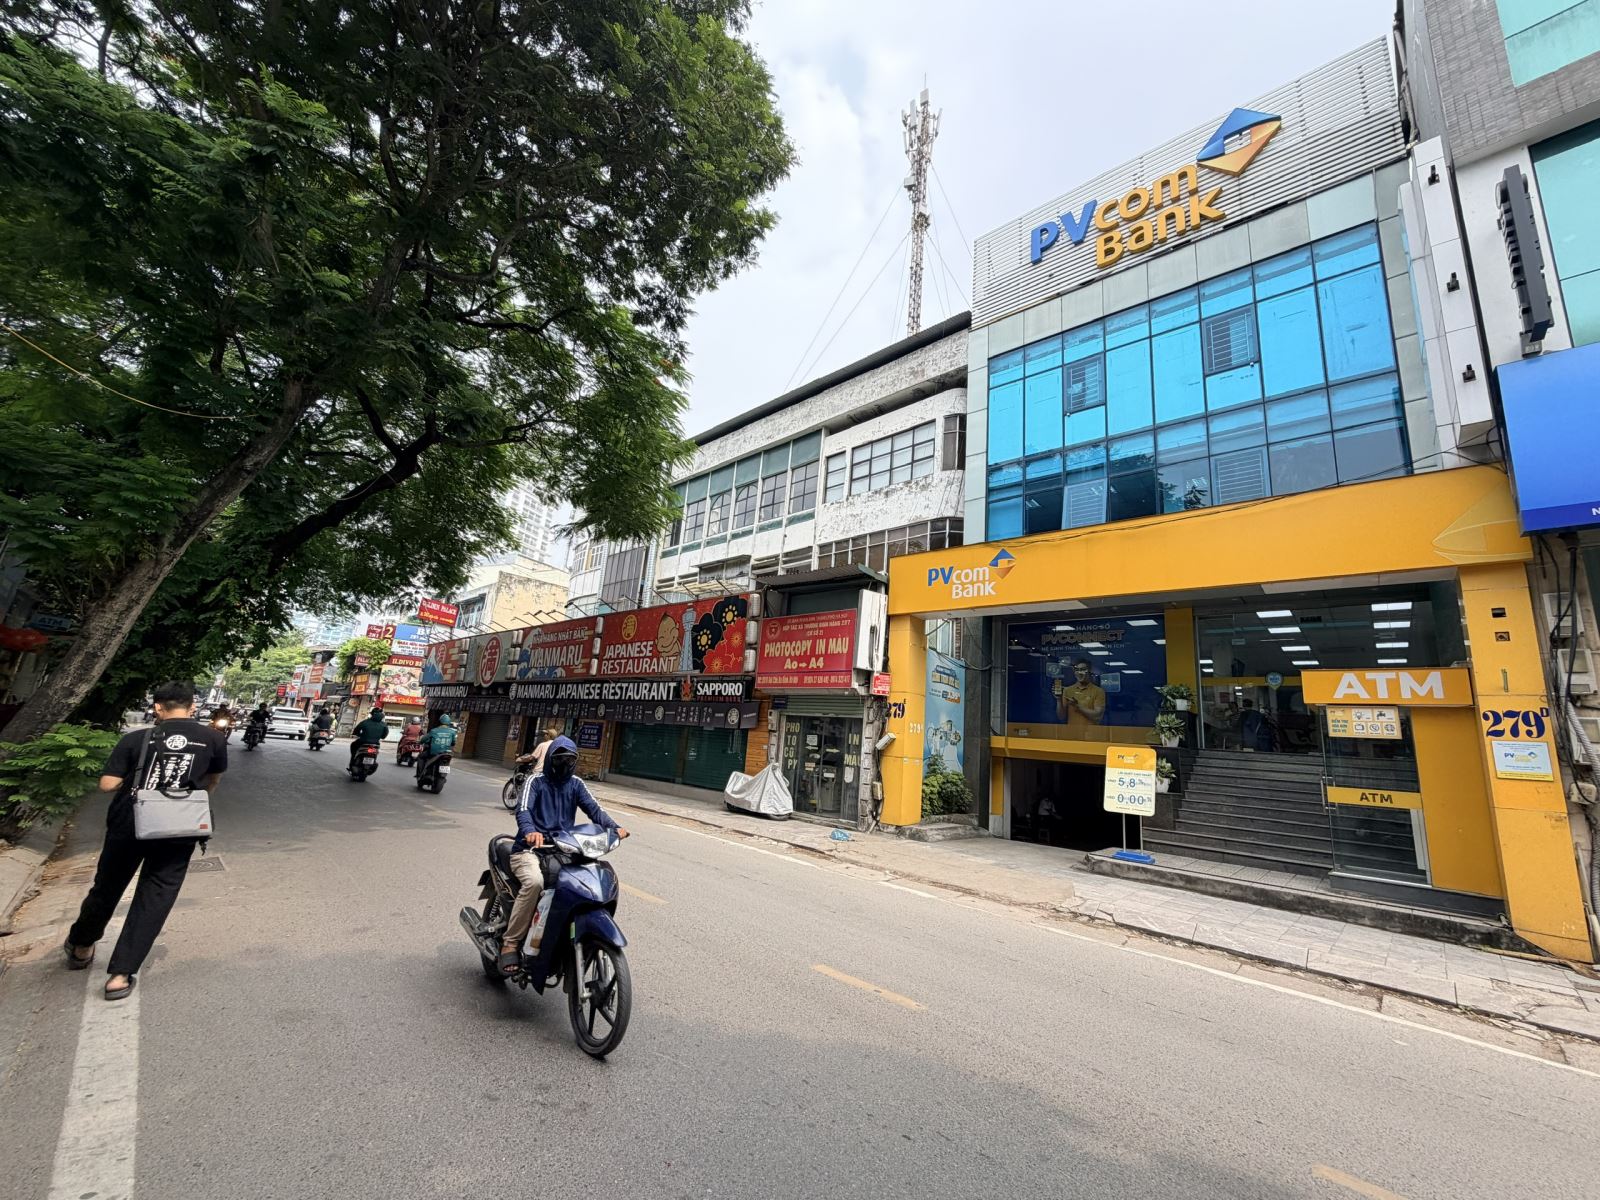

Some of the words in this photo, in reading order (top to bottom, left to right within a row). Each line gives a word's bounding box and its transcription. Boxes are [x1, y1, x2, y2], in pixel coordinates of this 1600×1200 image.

[38, 617, 64, 625] ATM
[603, 640, 654, 660] JAPANESE
[764, 639, 813, 658] PHOTOCOPY
[815, 638, 827, 655] IN
[828, 633, 849, 655] MÀU
[529, 644, 584, 668] MANMARU
[808, 656, 825, 669] A4
[600, 656, 677, 675] RESTAURANT
[517, 684, 556, 699] MANMARU
[556, 682, 602, 700] JAPANESE
[602, 681, 677, 700] RESTAURANT
[696, 682, 743, 696] SAPPORO
[1332, 671, 1445, 700] ATM
[785, 722, 800, 733] PHO
[787, 735, 797, 746] TO
[848, 733, 860, 746] IN
[784, 746, 794, 758] CO
[787, 759, 798, 770] PY
[1359, 792, 1393, 804] ATM
